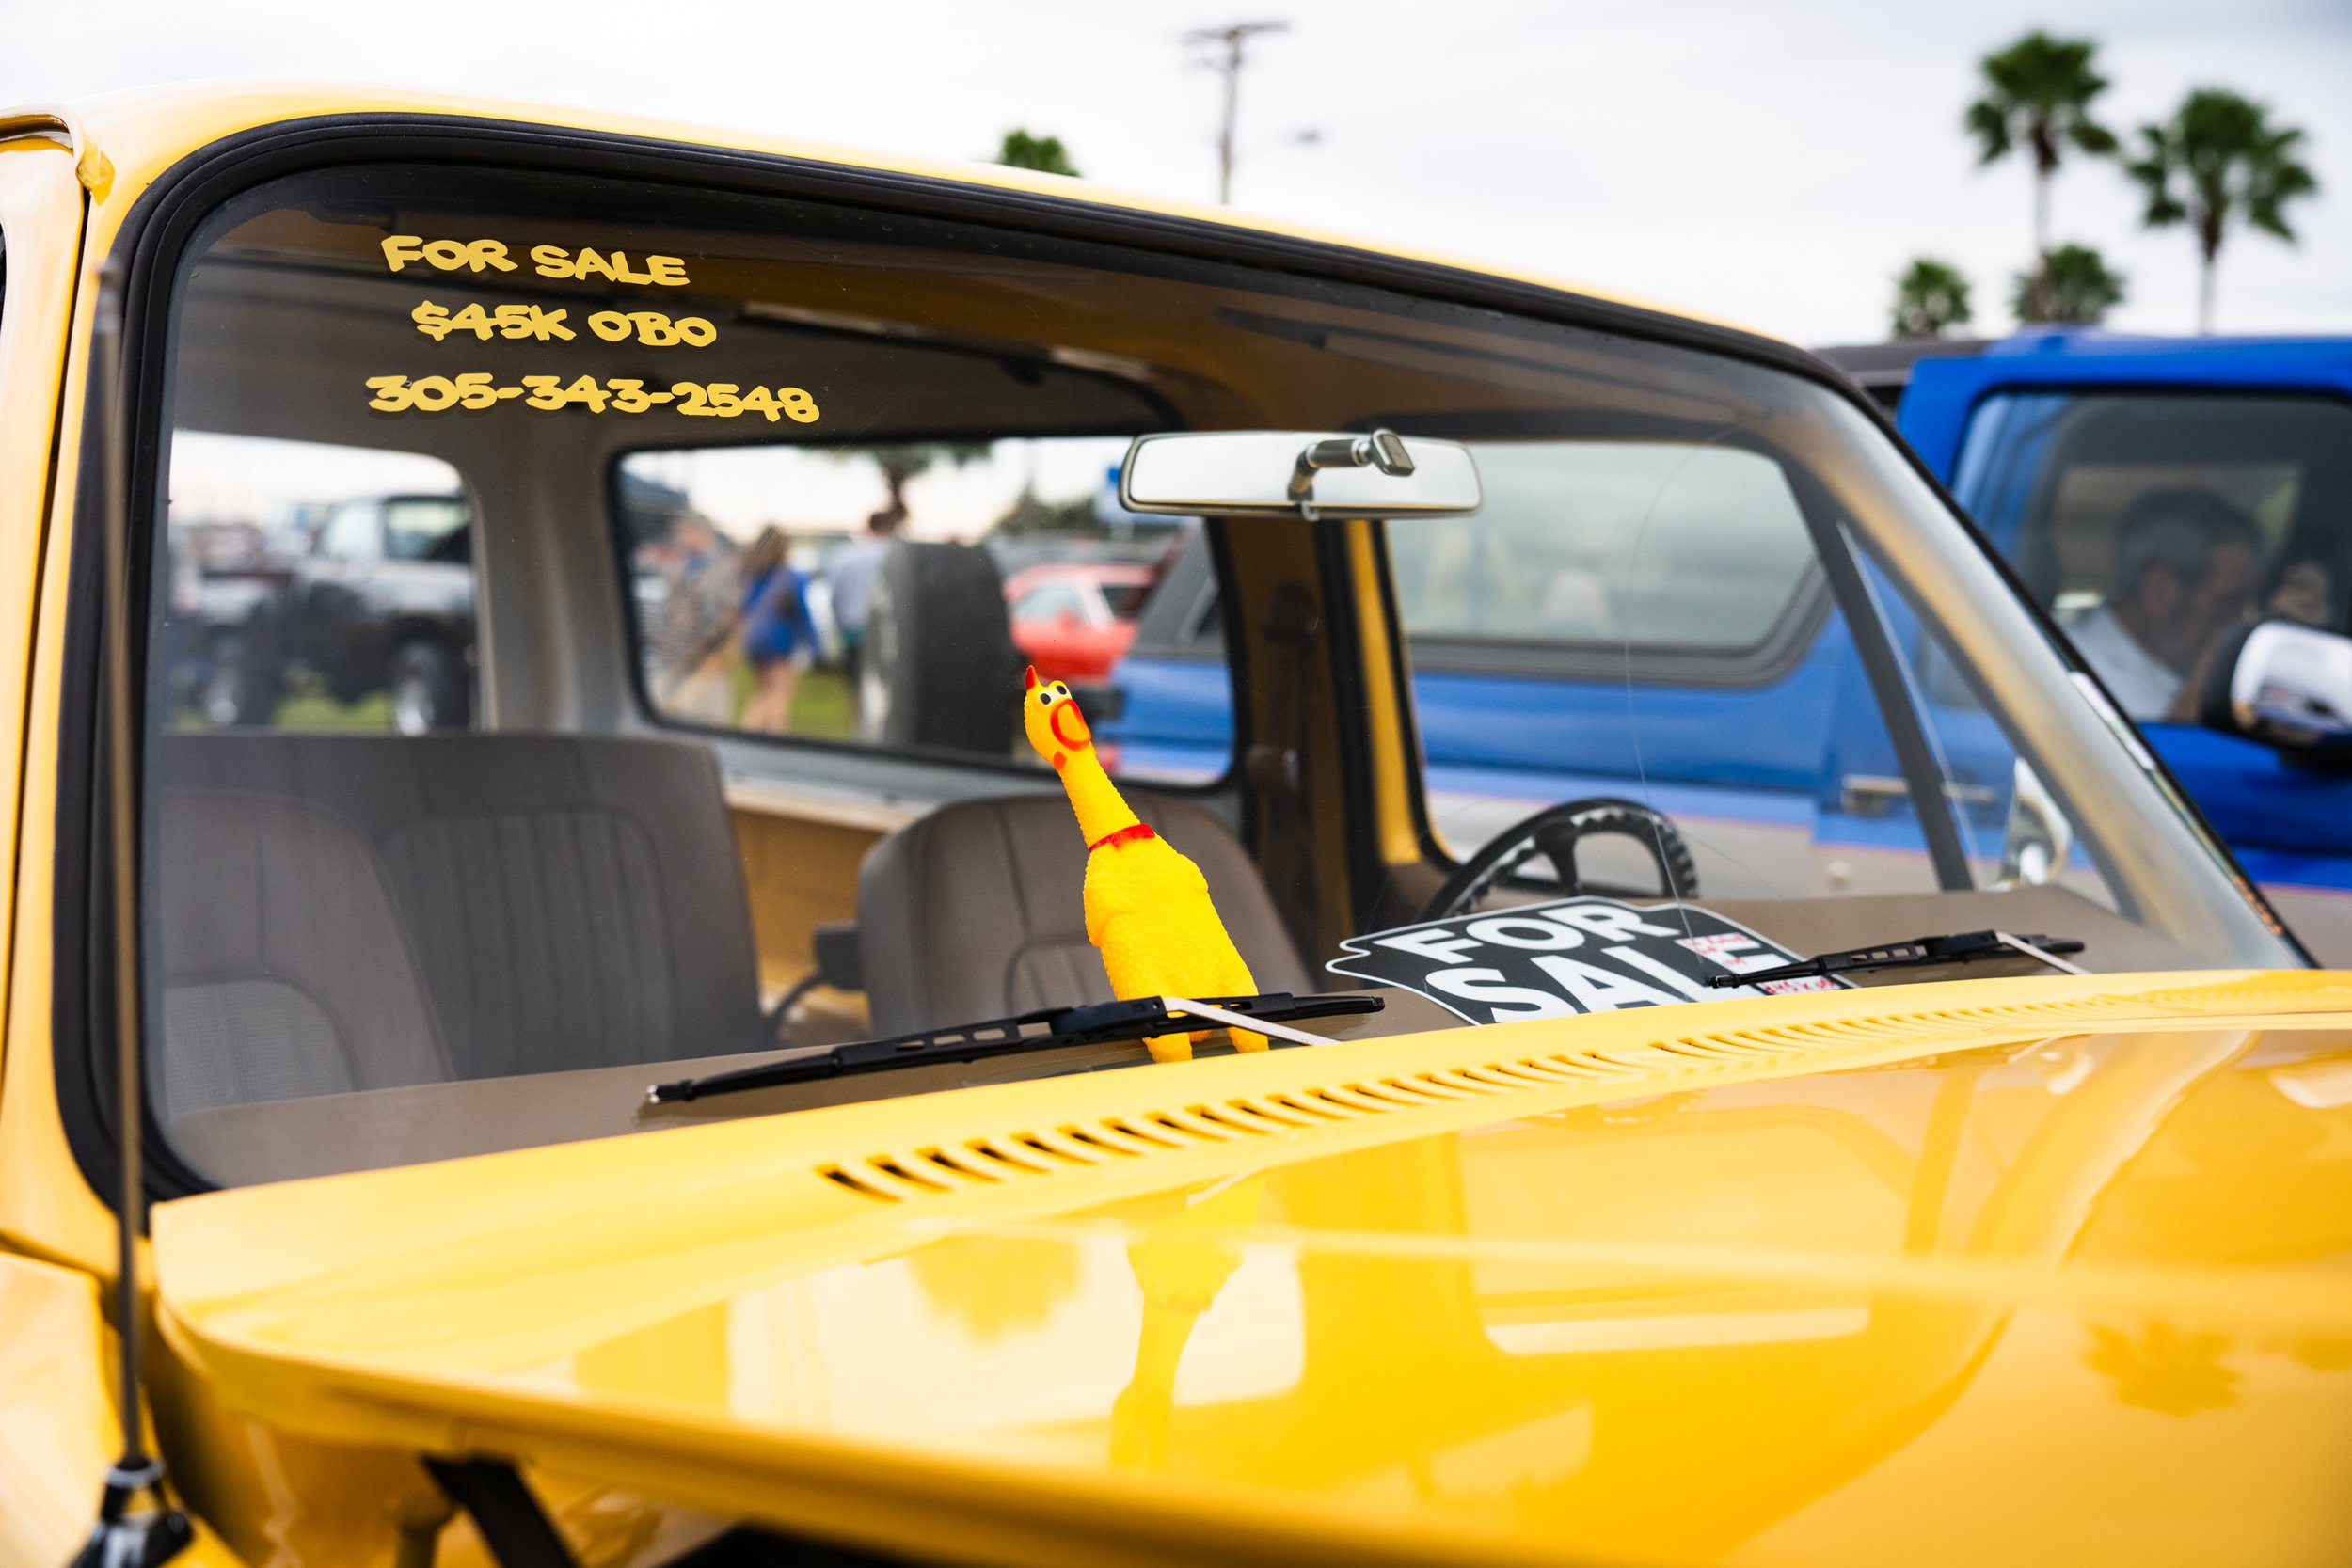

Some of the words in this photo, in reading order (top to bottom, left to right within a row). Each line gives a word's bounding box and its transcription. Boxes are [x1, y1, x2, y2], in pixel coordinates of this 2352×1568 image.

[381, 235, 518, 273] FOR
[530, 245, 691, 286] SALE
[411, 300, 577, 341] $45K
[587, 310, 717, 348] OBO
[365, 372, 820, 423] 305-343-2548
[1372, 905, 1681, 965] FOR
[1425, 931, 1842, 1024] SALE
